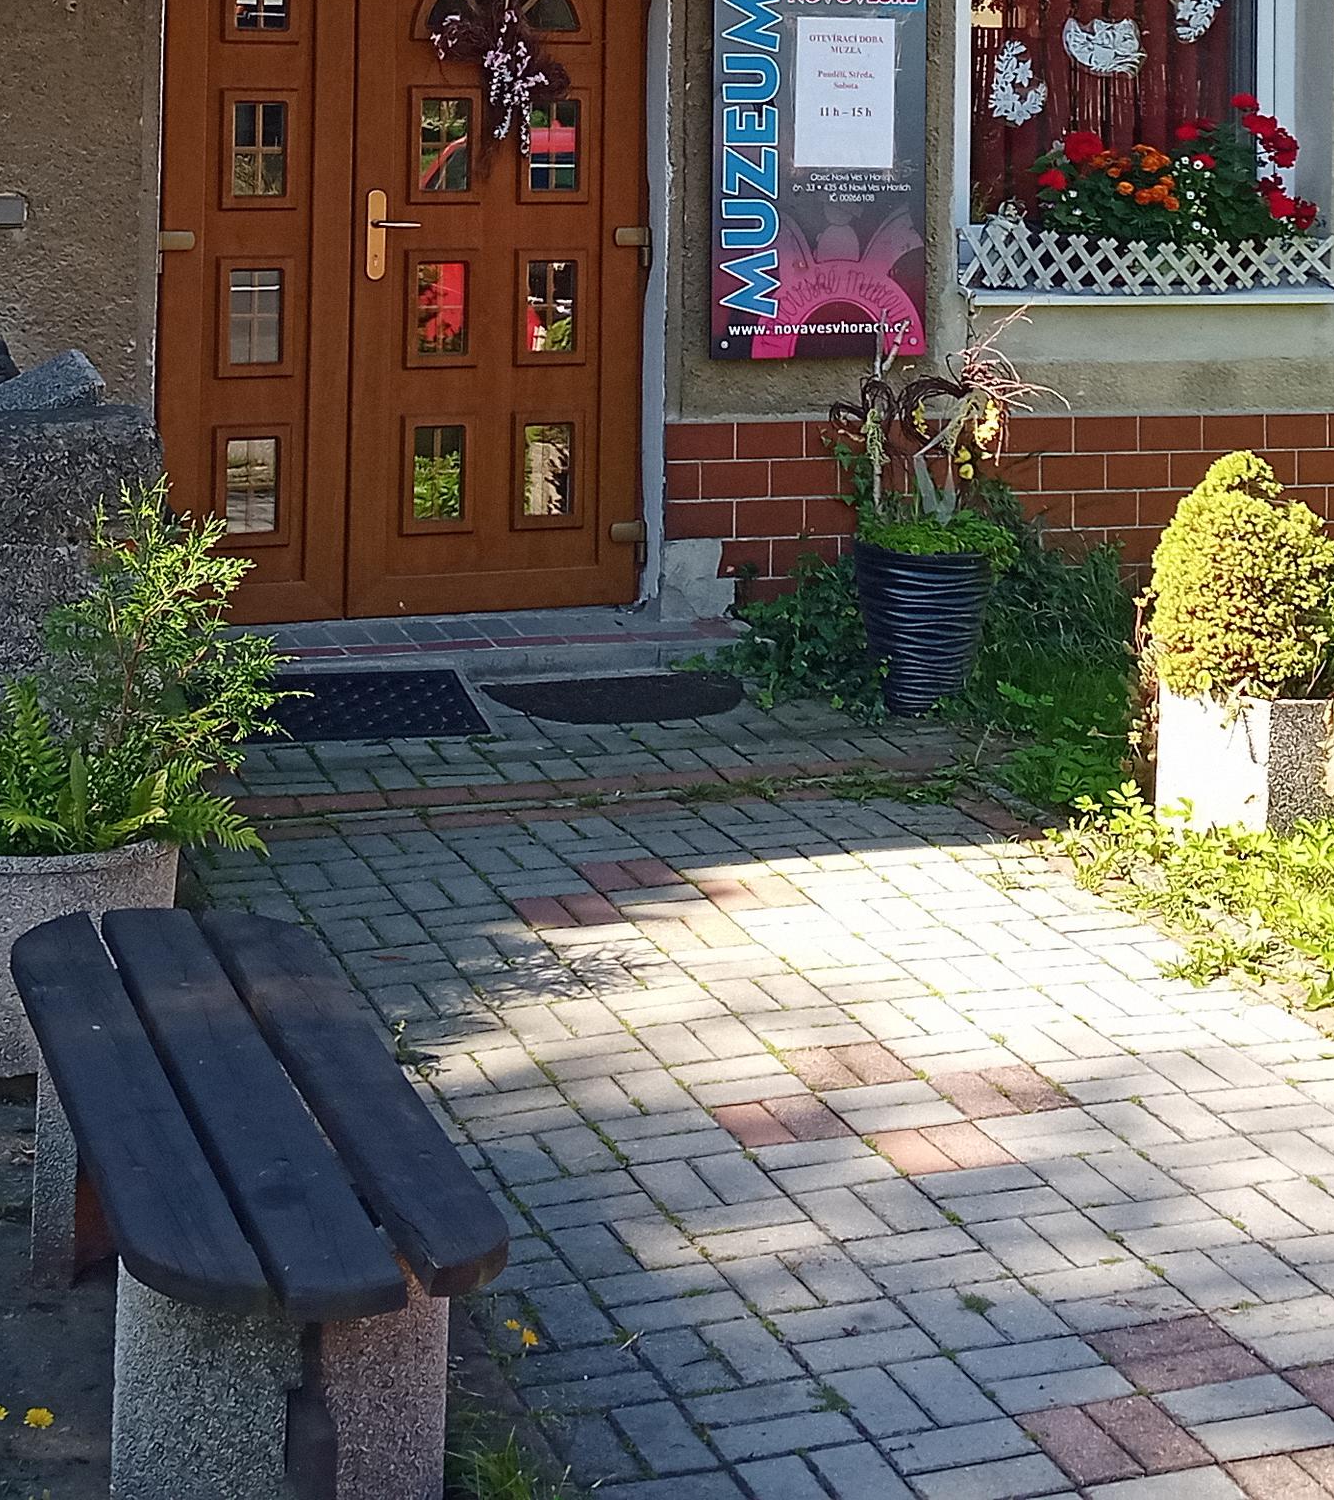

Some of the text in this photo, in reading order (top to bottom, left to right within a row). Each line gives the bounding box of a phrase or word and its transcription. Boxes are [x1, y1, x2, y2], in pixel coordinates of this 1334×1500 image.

[809, 33, 884, 44] OTEVÍRACÍ DOBA
[830, 45, 862, 55] MUZEA
[820, 107, 829, 117] 11
[833, 106, 840, 117] h
[852, 107, 863, 117] 15
[865, 107, 872, 117] h
[728, 325, 770, 336] www.
